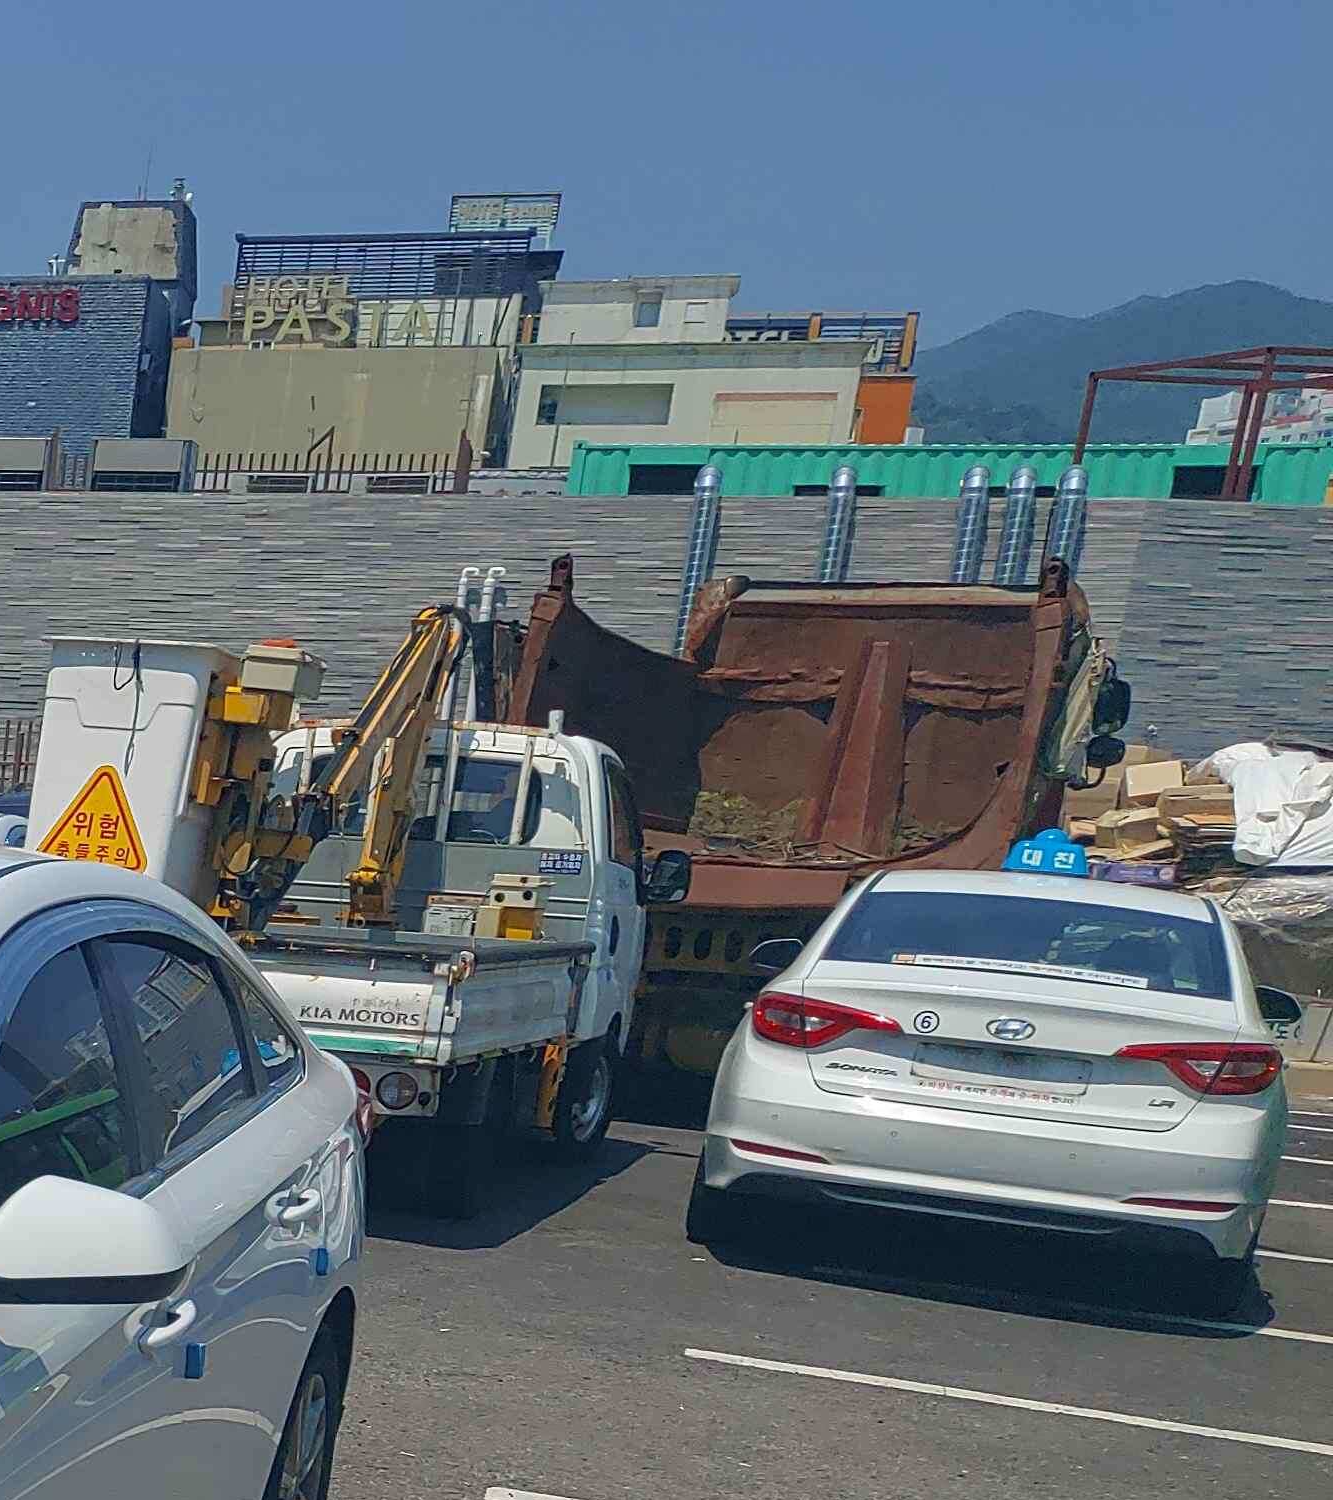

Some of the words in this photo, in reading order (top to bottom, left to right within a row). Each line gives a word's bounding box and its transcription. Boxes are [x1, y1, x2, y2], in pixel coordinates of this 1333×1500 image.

[247, 274, 357, 301] HOTEL
[243, 303, 436, 344] PASTA
[73, 812, 120, 840] 위험
[299, 1005, 332, 1019] KIA
[338, 1008, 420, 1026] MOTORS
[921, 1015, 933, 1029] 6
